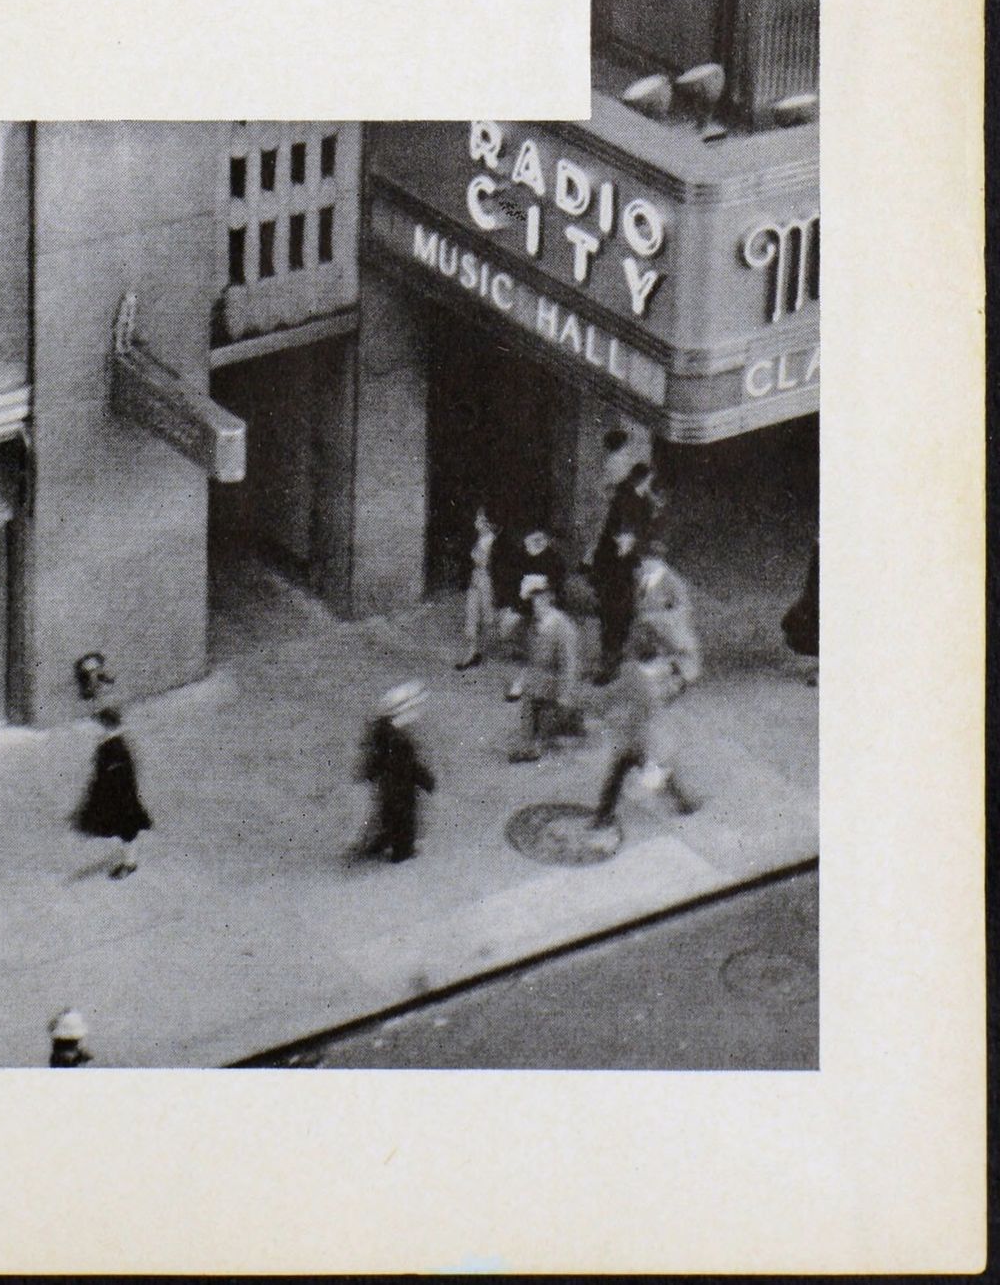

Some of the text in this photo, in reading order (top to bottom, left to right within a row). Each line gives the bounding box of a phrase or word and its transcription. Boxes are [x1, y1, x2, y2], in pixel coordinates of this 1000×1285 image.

[467, 174, 658, 315] CITY
[470, 121, 664, 256] RADIO
[414, 225, 628, 381] MUSIC HALL
